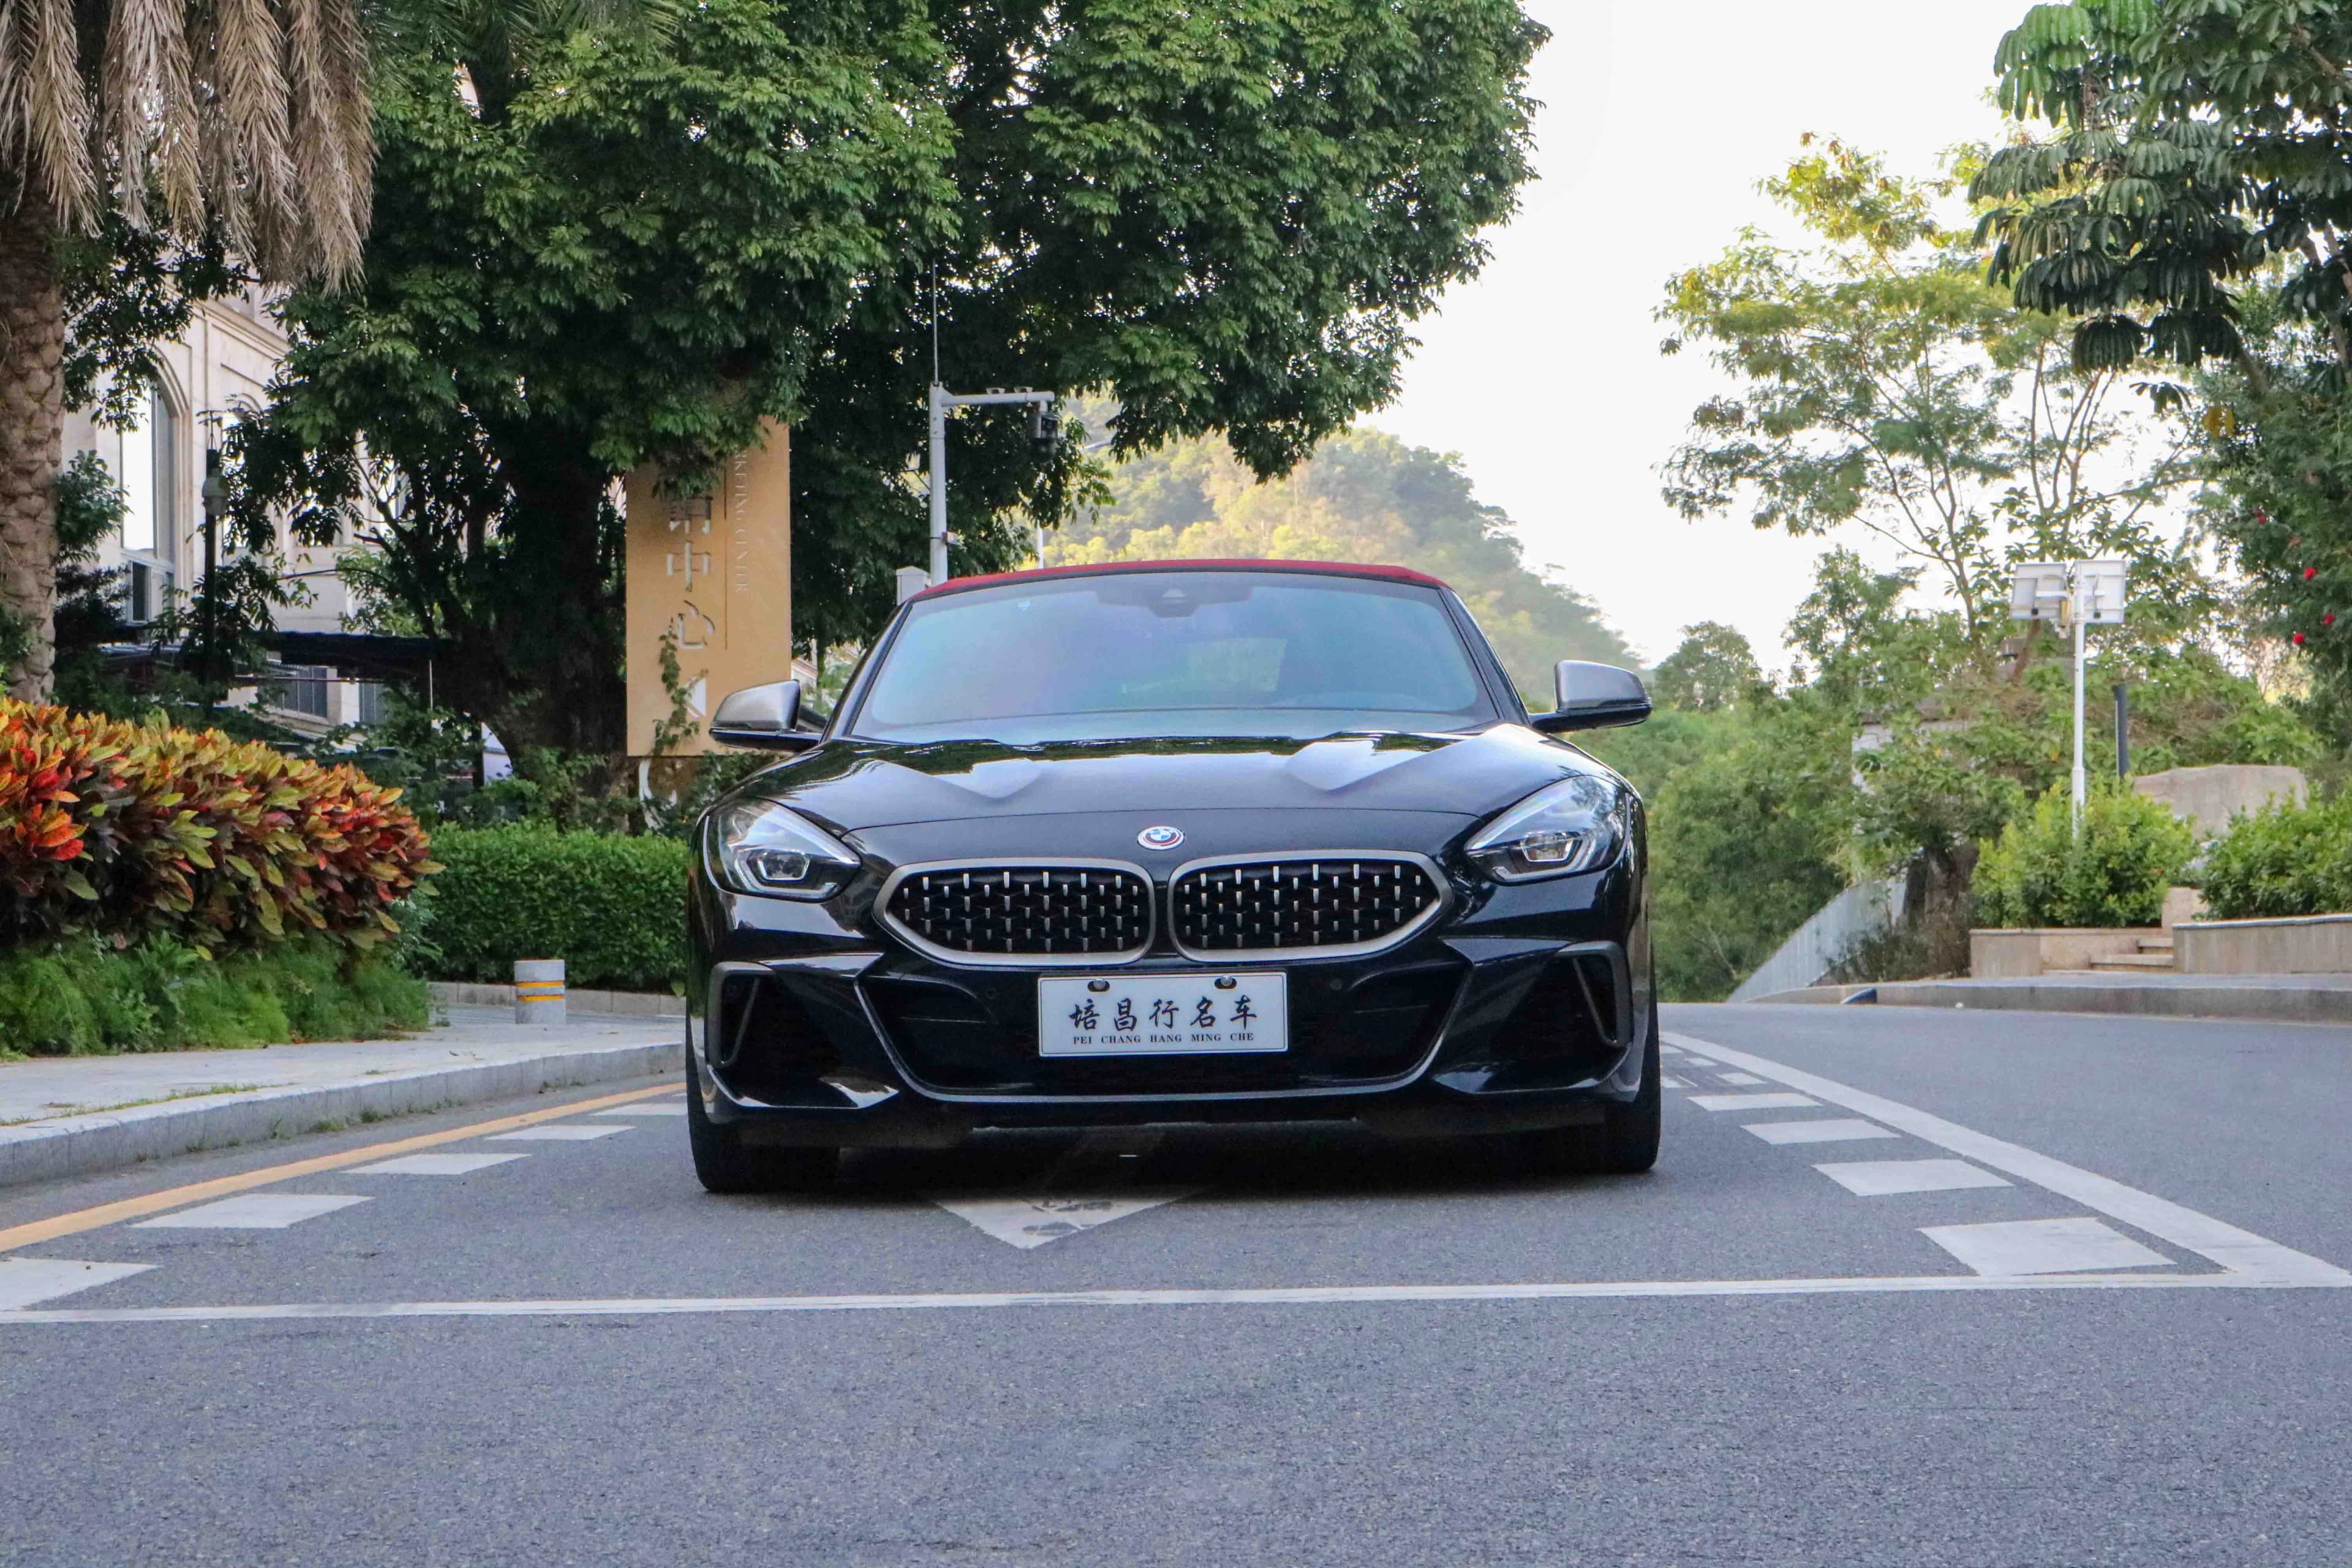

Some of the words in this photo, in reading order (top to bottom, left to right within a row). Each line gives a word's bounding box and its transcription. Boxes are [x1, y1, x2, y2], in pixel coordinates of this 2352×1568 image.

[1068, 994, 1257, 1031] 培昌行名车
[1073, 1036, 1093, 1044] PEI
[1101, 1035, 1141, 1044] CHANG
[1150, 1034, 1182, 1042] HANG
[1191, 1033, 1221, 1042] MING
[1230, 1033, 1254, 1041] CHE
